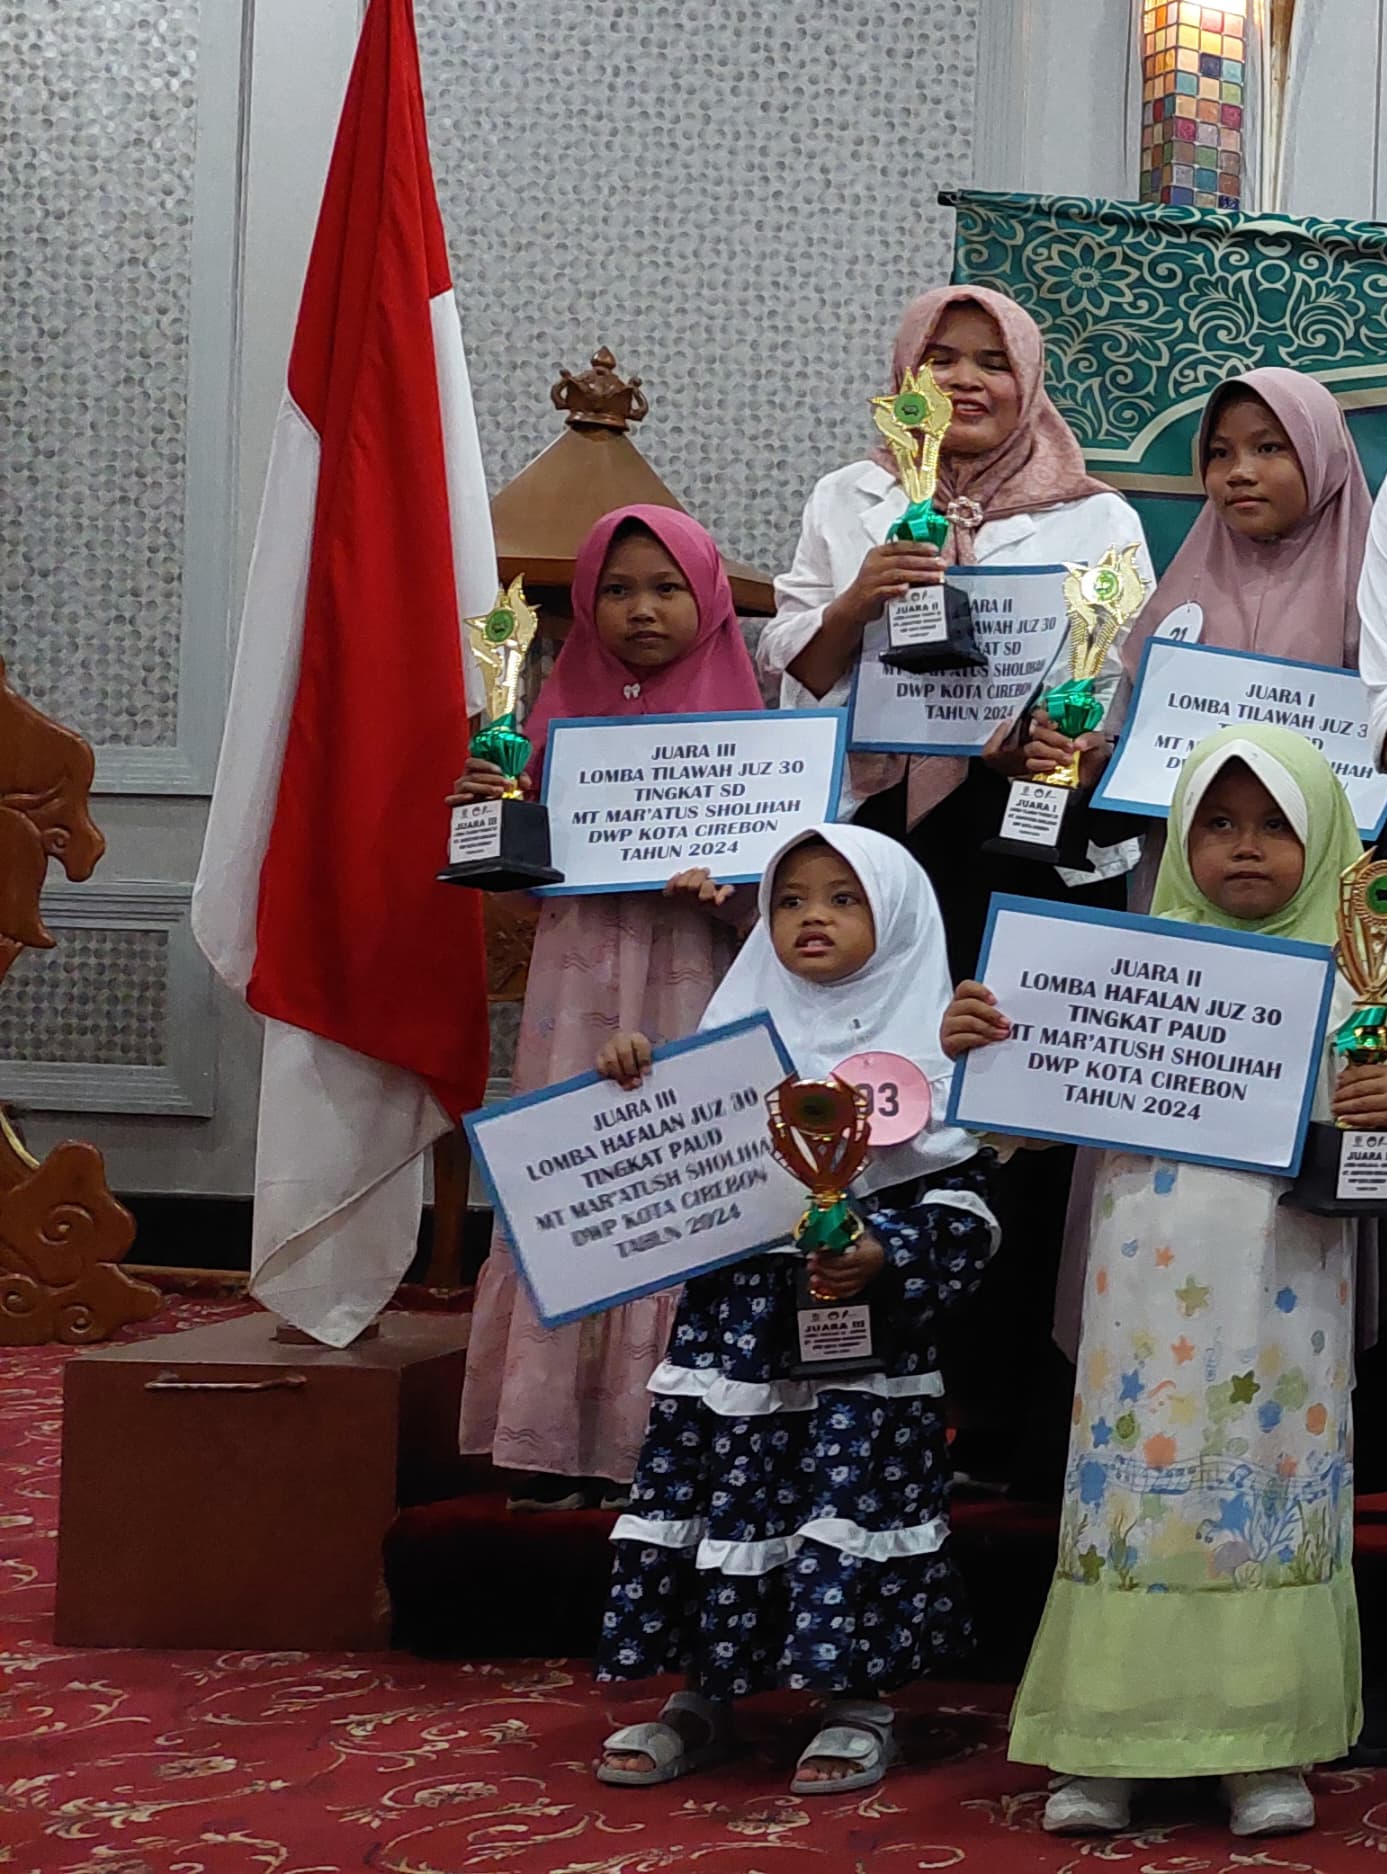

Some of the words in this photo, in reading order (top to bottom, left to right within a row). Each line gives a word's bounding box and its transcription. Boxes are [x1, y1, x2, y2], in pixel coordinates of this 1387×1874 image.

[896, 603, 929, 614] JUARA
[971, 599, 998, 613] ARA
[1003, 599, 1013, 613] II
[974, 620, 1013, 635] AWAH
[1017, 619, 1040, 634] JUZ
[1003, 642, 1022, 656] SD
[896, 683, 935, 698] DWP
[940, 683, 982, 698] KOTA
[1245, 684, 1302, 706] JUARA
[1307, 694, 1315, 707] I
[926, 705, 978, 720] TAHUN
[983, 705, 1014, 720] 2024
[1167, 693, 1230, 716] LOMBA
[1237, 704, 1315, 729] TILAWAH
[1319, 718, 1355, 736] JUZ
[651, 744, 709, 761] JUARA
[713, 743, 736, 757] III
[1154, 735, 1184, 750] MT
[579, 766, 645, 785] LOMBA
[651, 763, 732, 782] TILAWAH
[737, 761, 774, 778] JUZ
[778, 759, 805, 775] 30
[633, 783, 715, 802] TINGKAT
[719, 782, 746, 798] SD
[1016, 799, 1050, 811] JUARA
[572, 810, 600, 825] MT
[605, 805, 699, 824] MAR'ATUS
[704, 799, 802, 819] SHOLIHAH
[587, 827, 633, 844] DWP
[638, 824, 693, 841] KOTA
[697, 818, 778, 837] CIREBON
[620, 843, 684, 862] TAHUN
[688, 840, 739, 857] 2024
[1111, 958, 1179, 986] JUARA
[1187, 968, 1203, 987] II
[1020, 970, 1097, 998] LOMBA
[1103, 983, 1200, 1014] HAFALAN
[1204, 999, 1246, 1021] JUZ
[1251, 1006, 1282, 1026] 30
[1067, 1004, 1163, 1035] TINGKAT
[1168, 1020, 1227, 1045] PAUD
[1039, 1028, 1165, 1062] MAR'ATUSH
[1170, 1047, 1282, 1080] SHOLIHAH
[1027, 1052, 1080, 1076] DWP
[1085, 1062, 1143, 1086] KOTA
[1150, 1071, 1248, 1101] CIREBON
[593, 1099, 652, 1131] JUARA
[654, 1088, 677, 1108] III
[1063, 1083, 1135, 1111] TAHUN
[1142, 1097, 1201, 1121] 2024
[526, 1145, 599, 1182] LOMBA
[600, 1113, 685, 1155] HAFALAN
[690, 1099, 724, 1126] JUZ
[733, 1087, 758, 1113] 30
[581, 1148, 664, 1188] TINGKAT
[669, 1127, 723, 1159] PAUD
[1347, 1152, 1382, 1160] JUARA
[536, 1210, 565, 1231] MT
[685, 1137, 772, 1179] SHOLIHA
[623, 1199, 677, 1230] KOTA
[805, 1323, 848, 1332] JUARA
